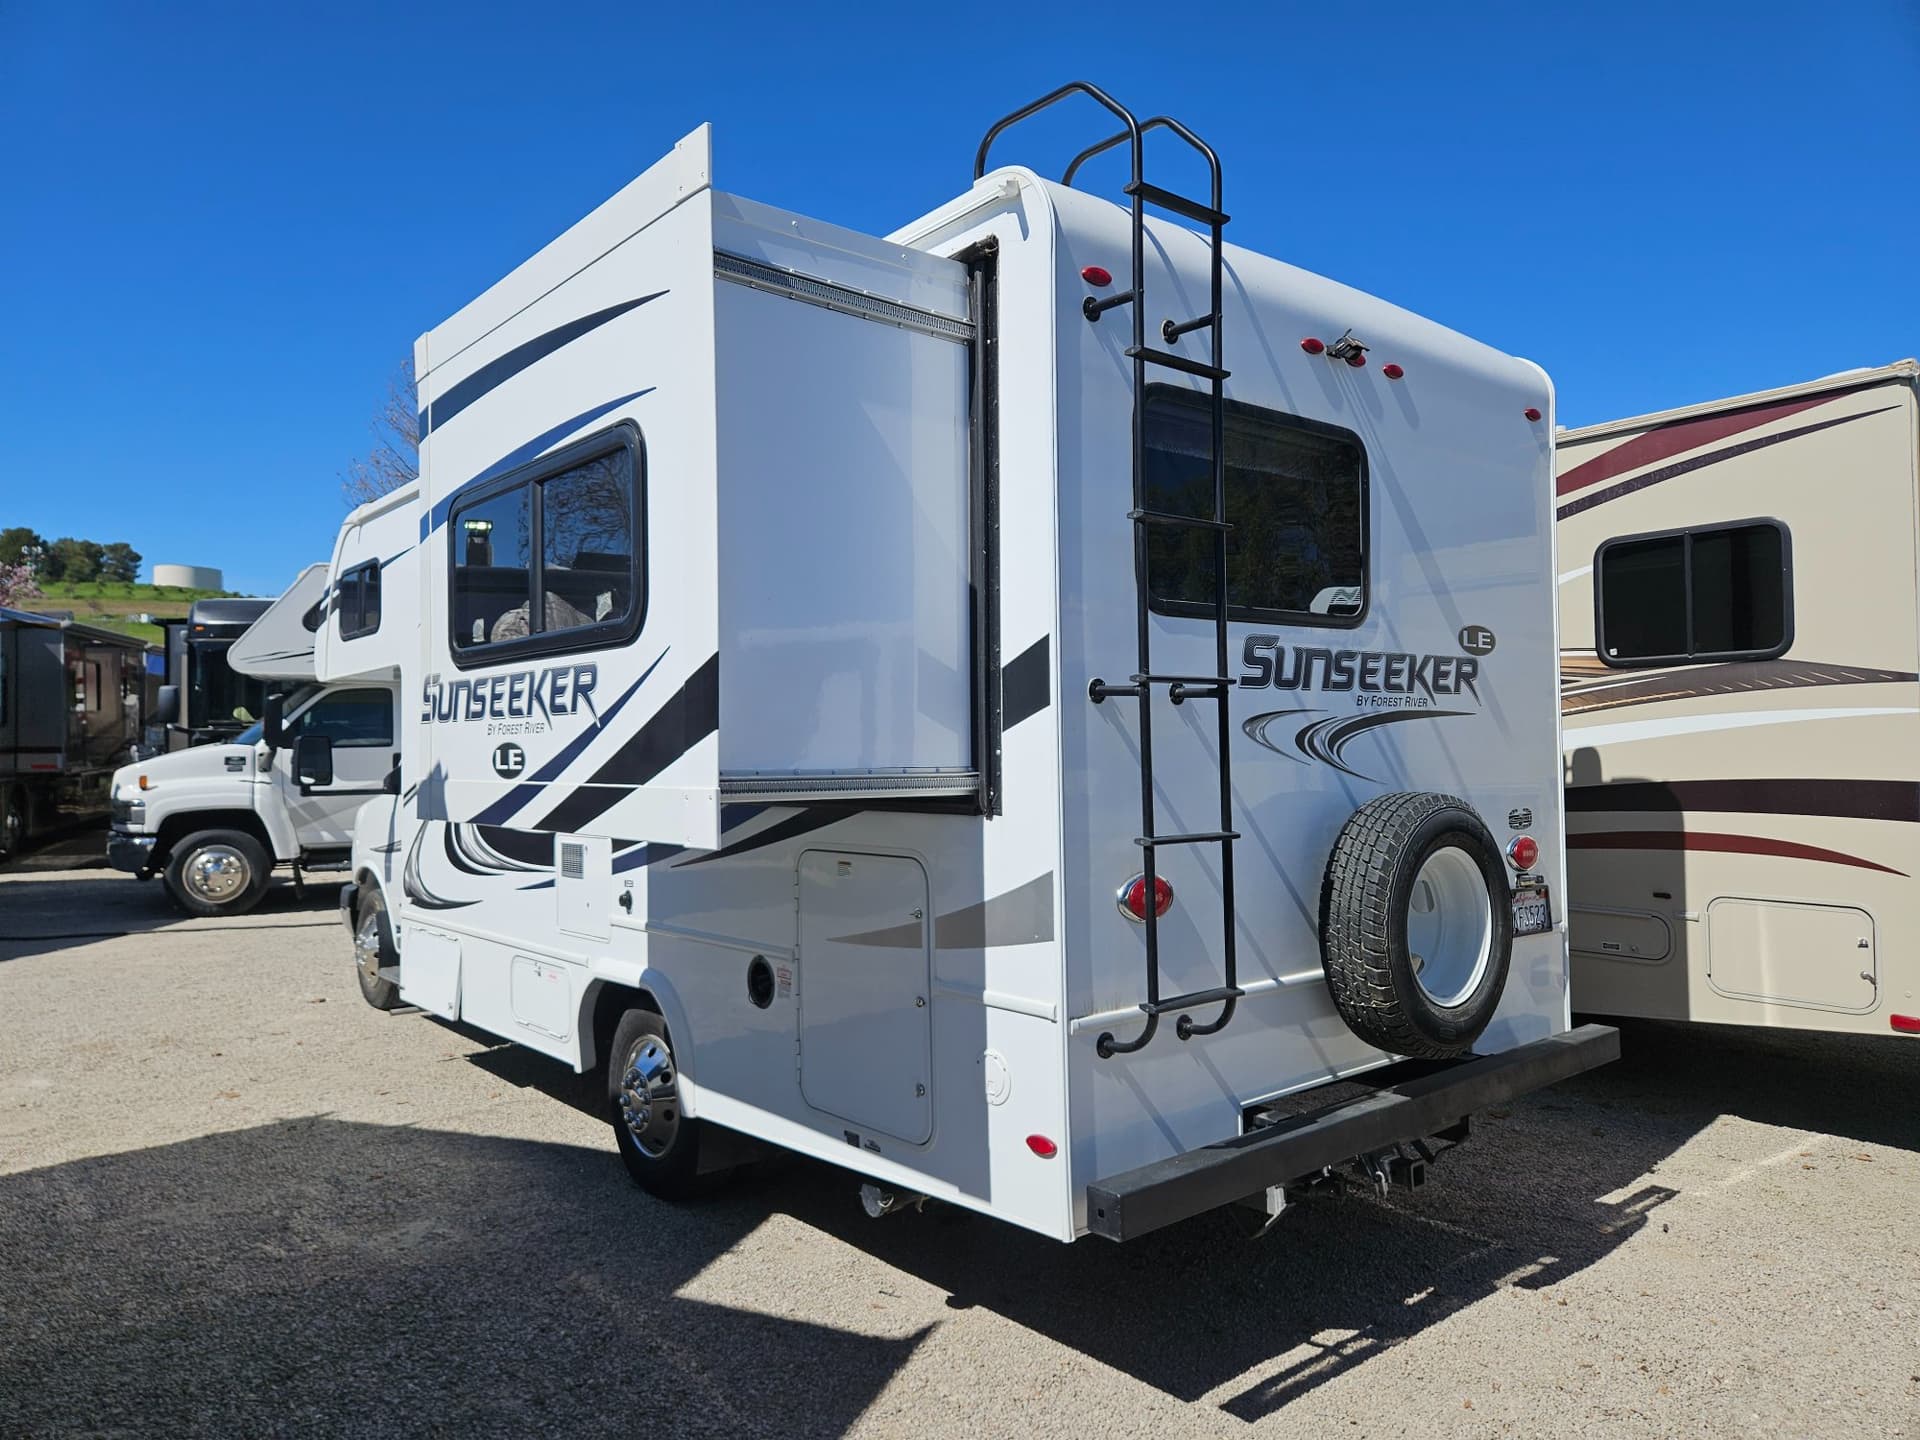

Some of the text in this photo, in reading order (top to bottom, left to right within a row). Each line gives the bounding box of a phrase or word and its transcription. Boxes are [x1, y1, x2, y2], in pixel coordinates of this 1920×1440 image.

[1462, 630, 1493, 650] LE
[1238, 633, 1482, 707] SUNSEEKER
[420, 661, 600, 730] SUNSEEKER
[1370, 695, 1403, 708] FOREST
[1405, 696, 1428, 708] RIVER
[497, 722, 523, 735] FOREST
[524, 720, 545, 734] RIVER
[494, 748, 523, 770] LE
